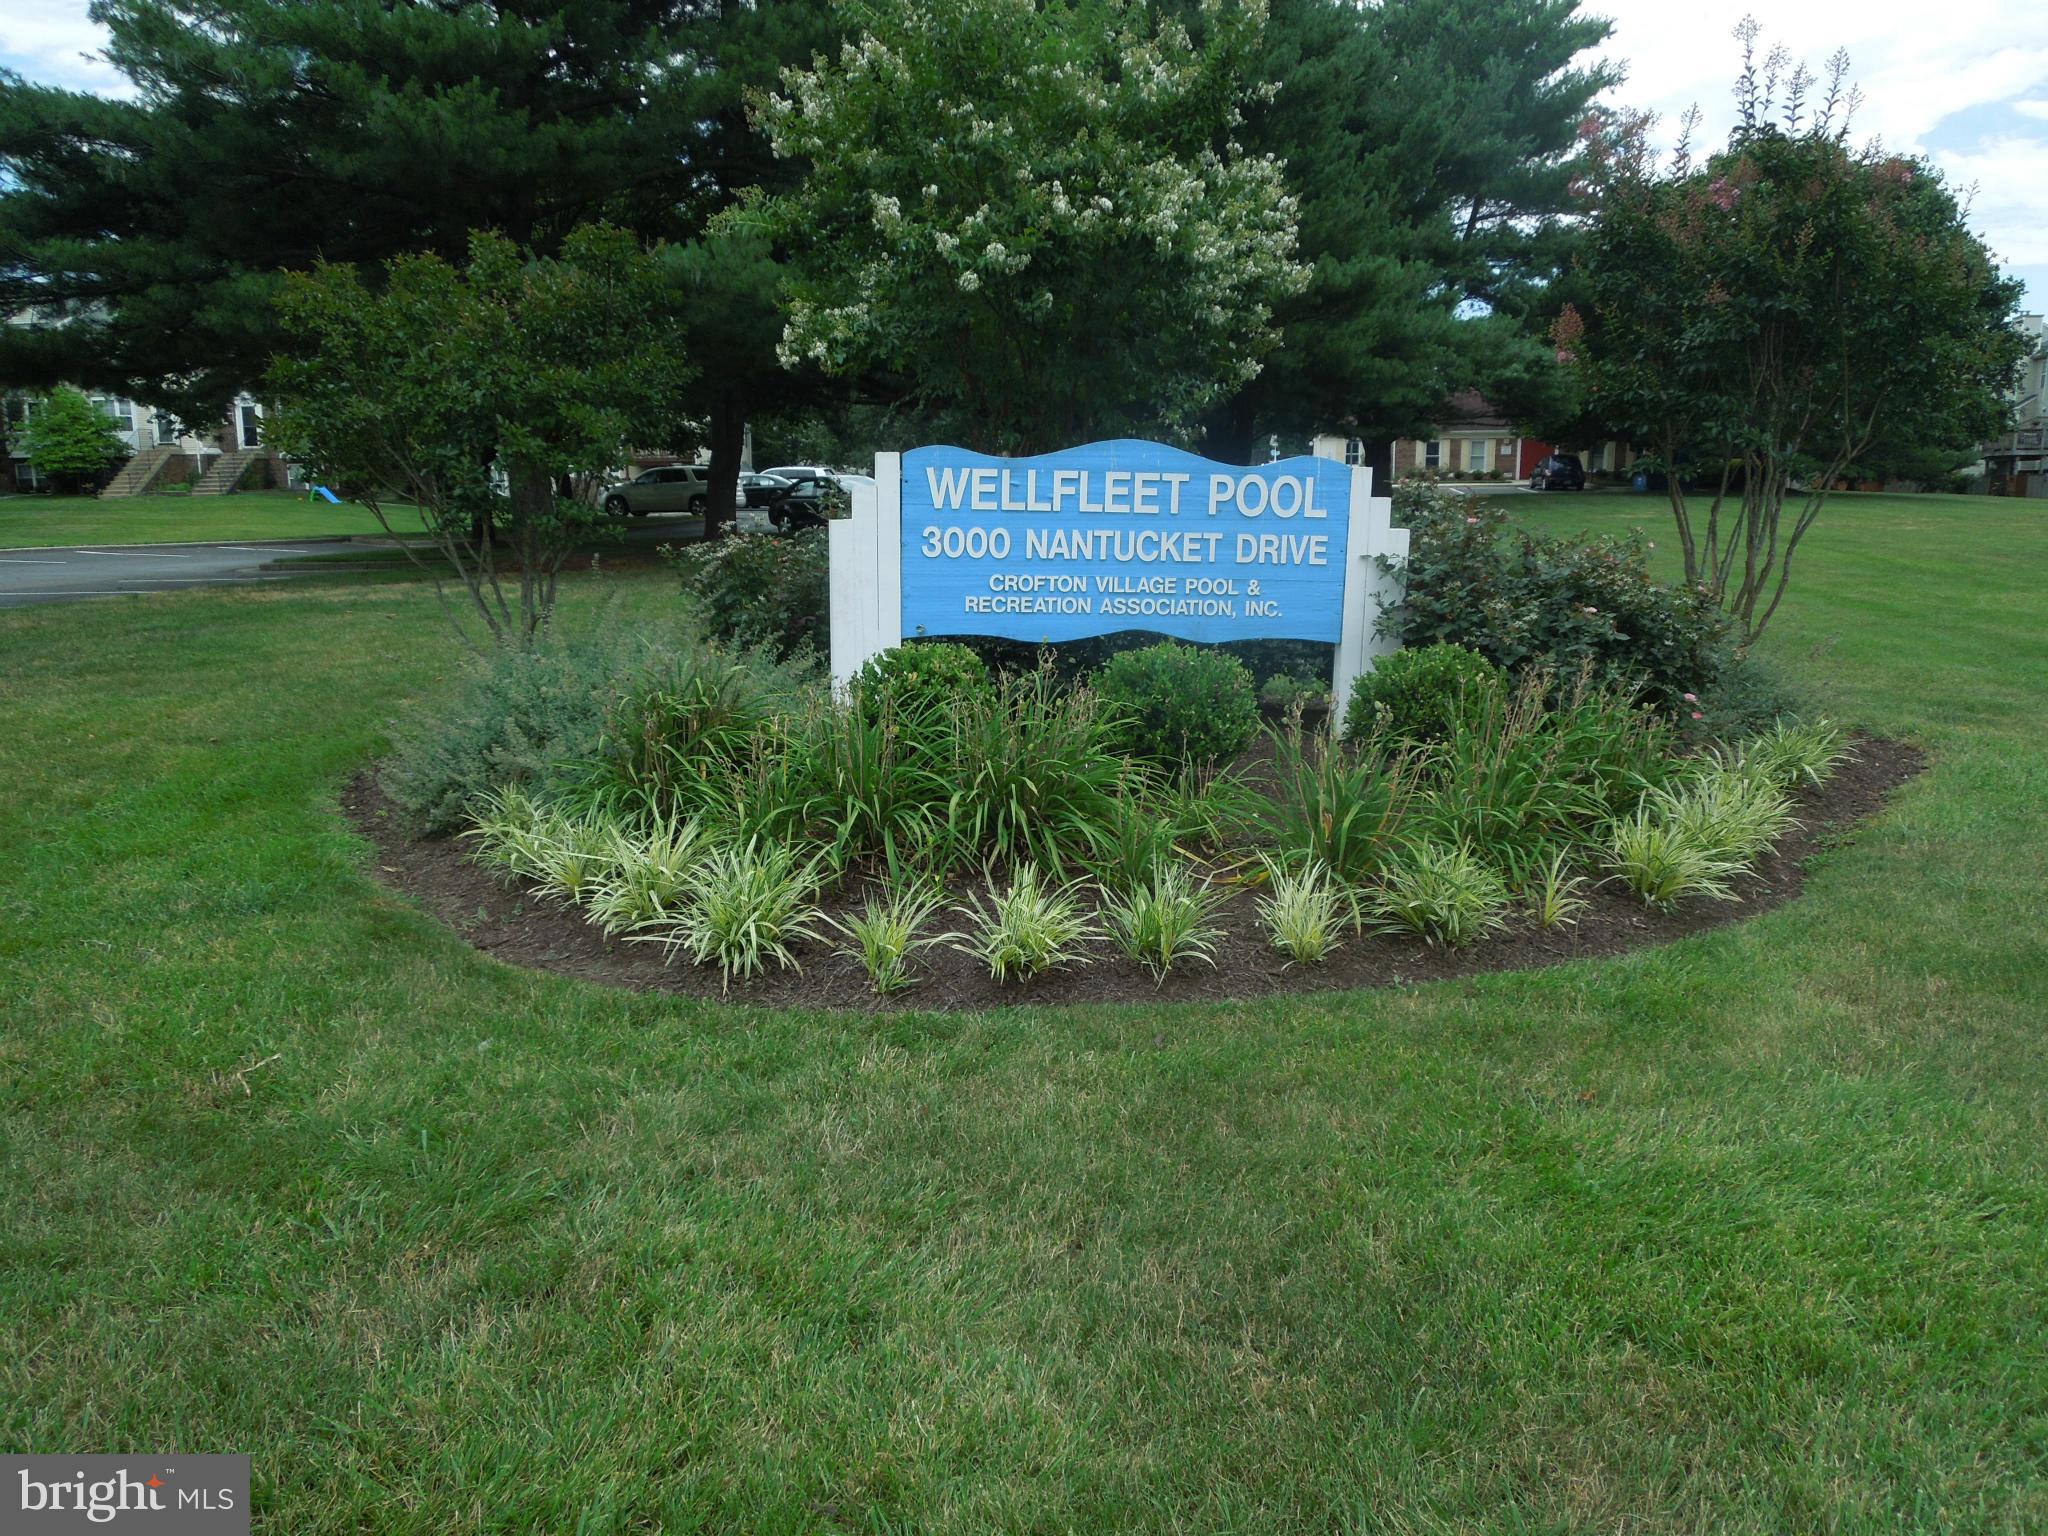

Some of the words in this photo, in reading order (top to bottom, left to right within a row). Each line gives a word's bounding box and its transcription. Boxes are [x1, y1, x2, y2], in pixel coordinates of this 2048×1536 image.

[926, 467, 1189, 515] WELLFLEET
[1208, 474, 1327, 518] POOL
[921, 526, 1010, 559] 3000
[1026, 529, 1223, 562] NANTUCKET
[1236, 534, 1328, 566] DRIVE
[989, 574, 1087, 592] CROFTON
[1096, 576, 1176, 594] VILLAGE
[1185, 578, 1238, 596] POOL
[1248, 580, 1260, 596] &
[965, 597, 1091, 614] RECREATION
[1100, 598, 1237, 619] ASSOCIATION,
[1245, 600, 1282, 618] INC.
